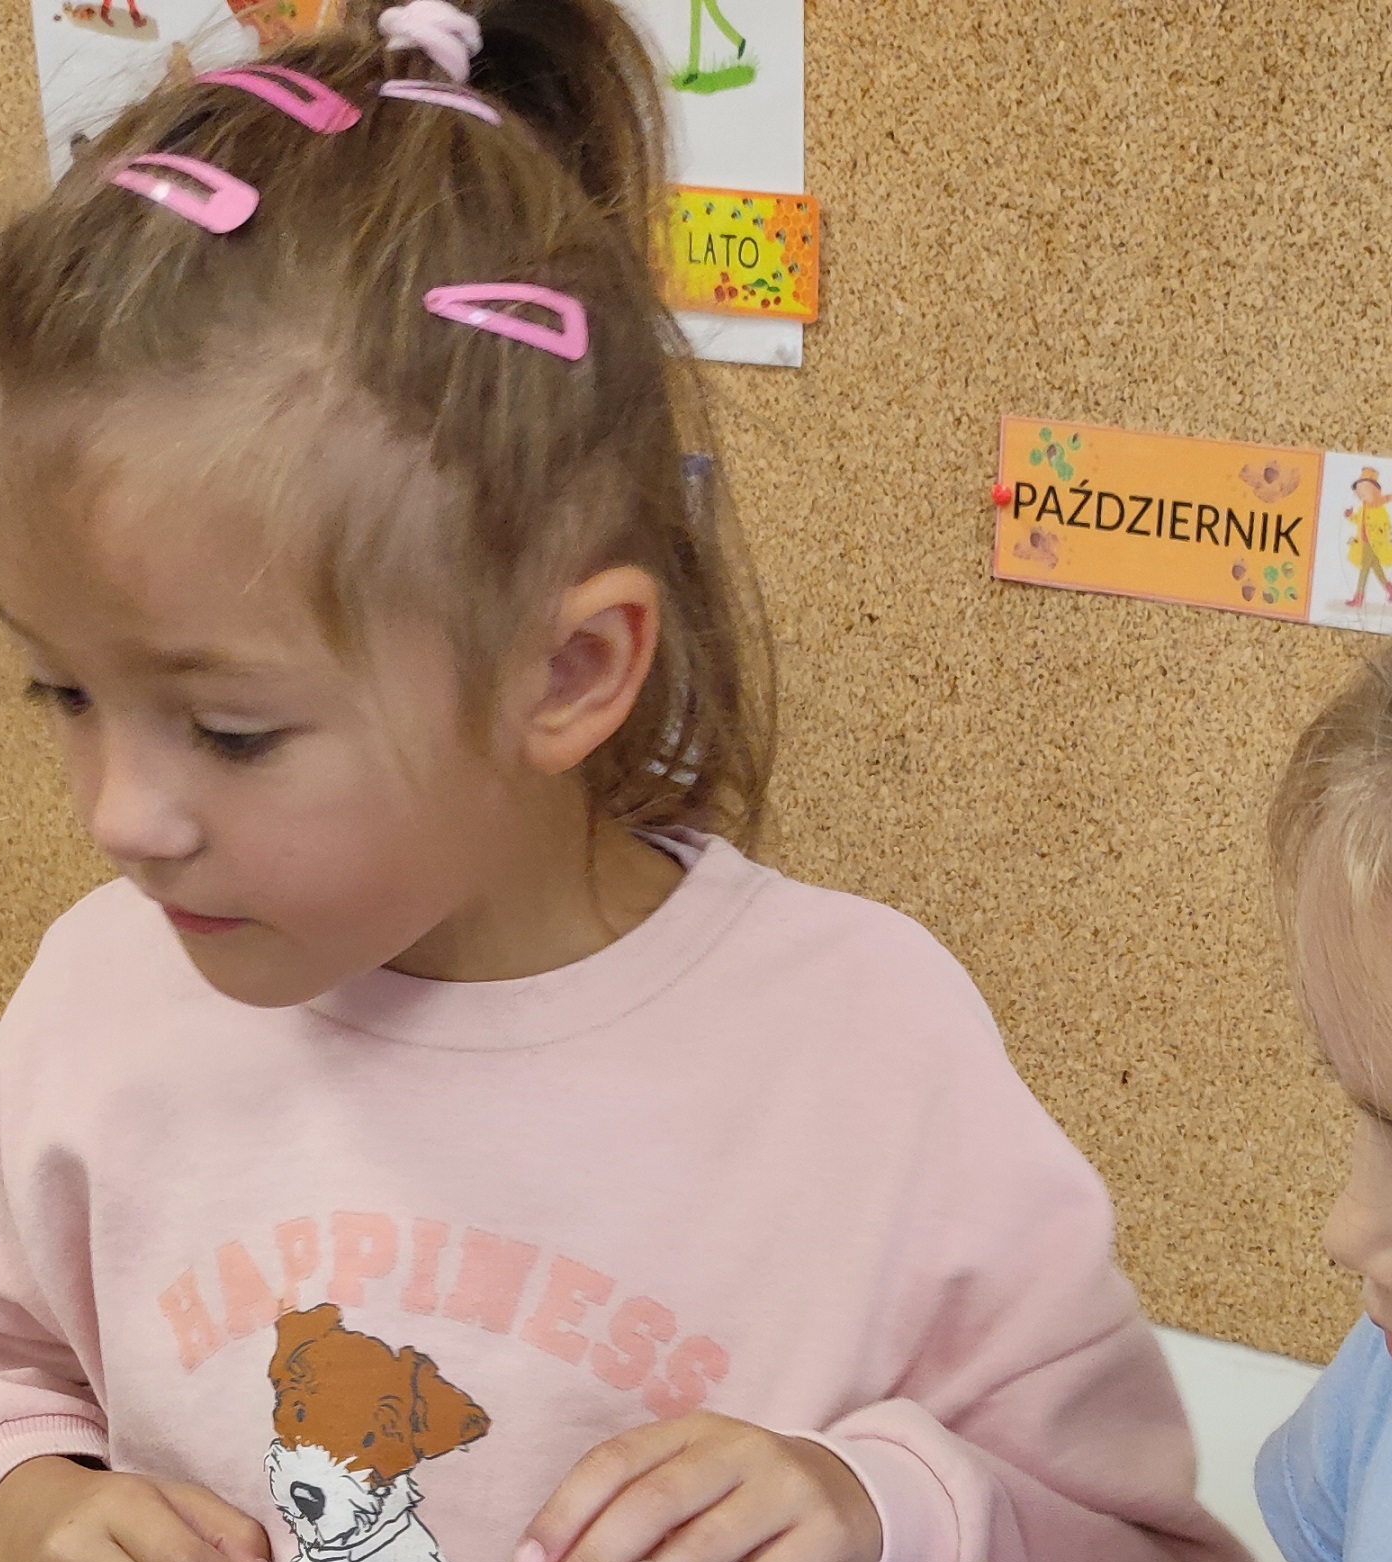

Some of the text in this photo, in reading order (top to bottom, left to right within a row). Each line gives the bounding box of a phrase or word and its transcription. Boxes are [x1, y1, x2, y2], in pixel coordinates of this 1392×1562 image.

[688, 231, 760, 269] LATO
[1012, 479, 1305, 556] PAŹDZIERNIK
[156, 1210, 731, 1421] HAPPINESS
